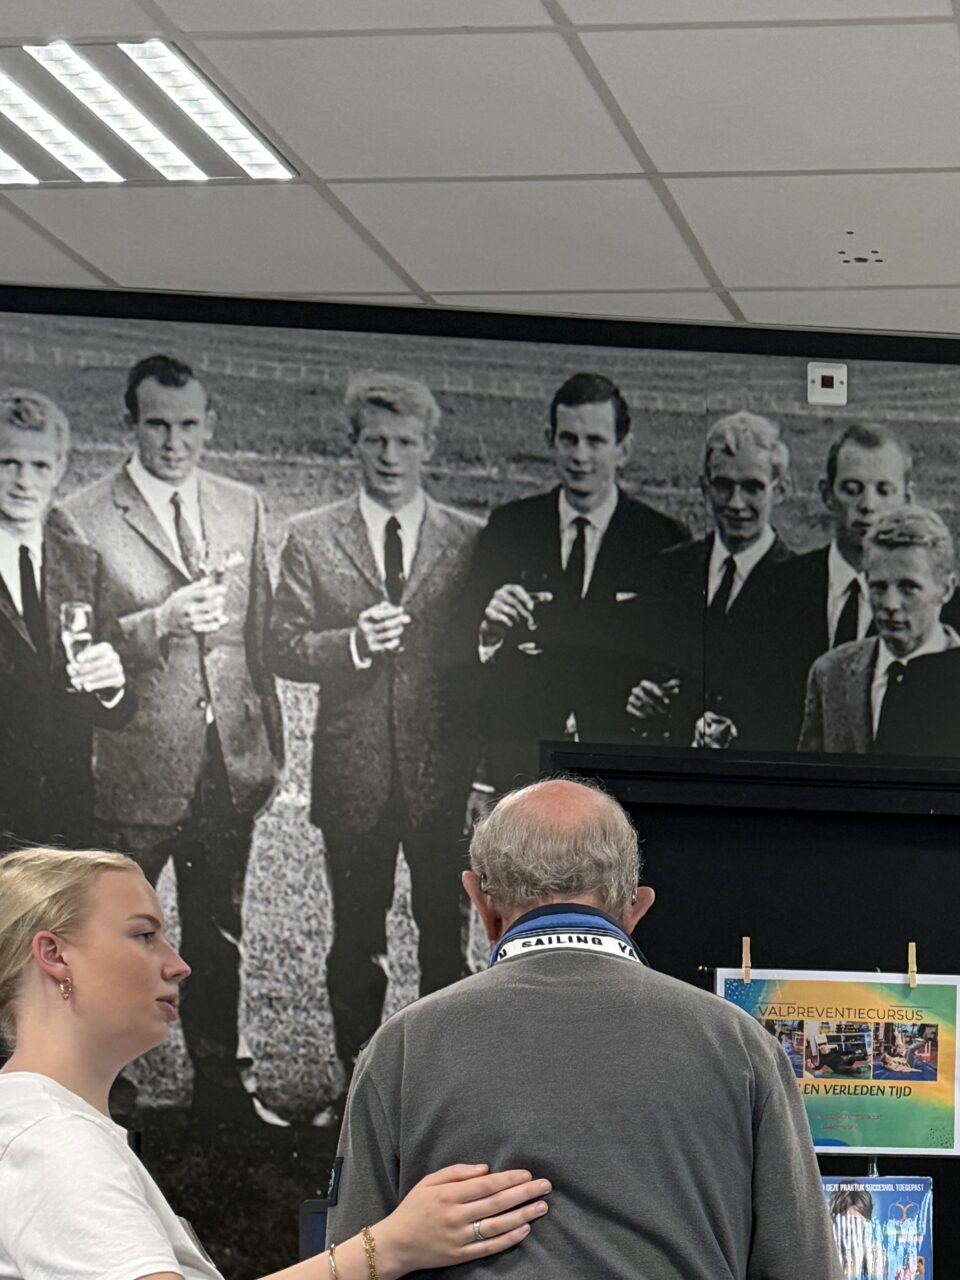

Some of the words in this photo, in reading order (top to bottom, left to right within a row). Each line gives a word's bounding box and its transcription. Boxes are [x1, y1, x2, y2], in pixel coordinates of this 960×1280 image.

[521, 935, 603, 948] SAILING
[758, 1005, 924, 1021] VALPREVENTIECURSUS
[823, 1084, 885, 1097] VERLEDEN
[888, 1085, 913, 1099] TIJD
[825, 1183, 839, 1192] DEZE
[895, 1183, 924, 1192] TOEGEPAST
